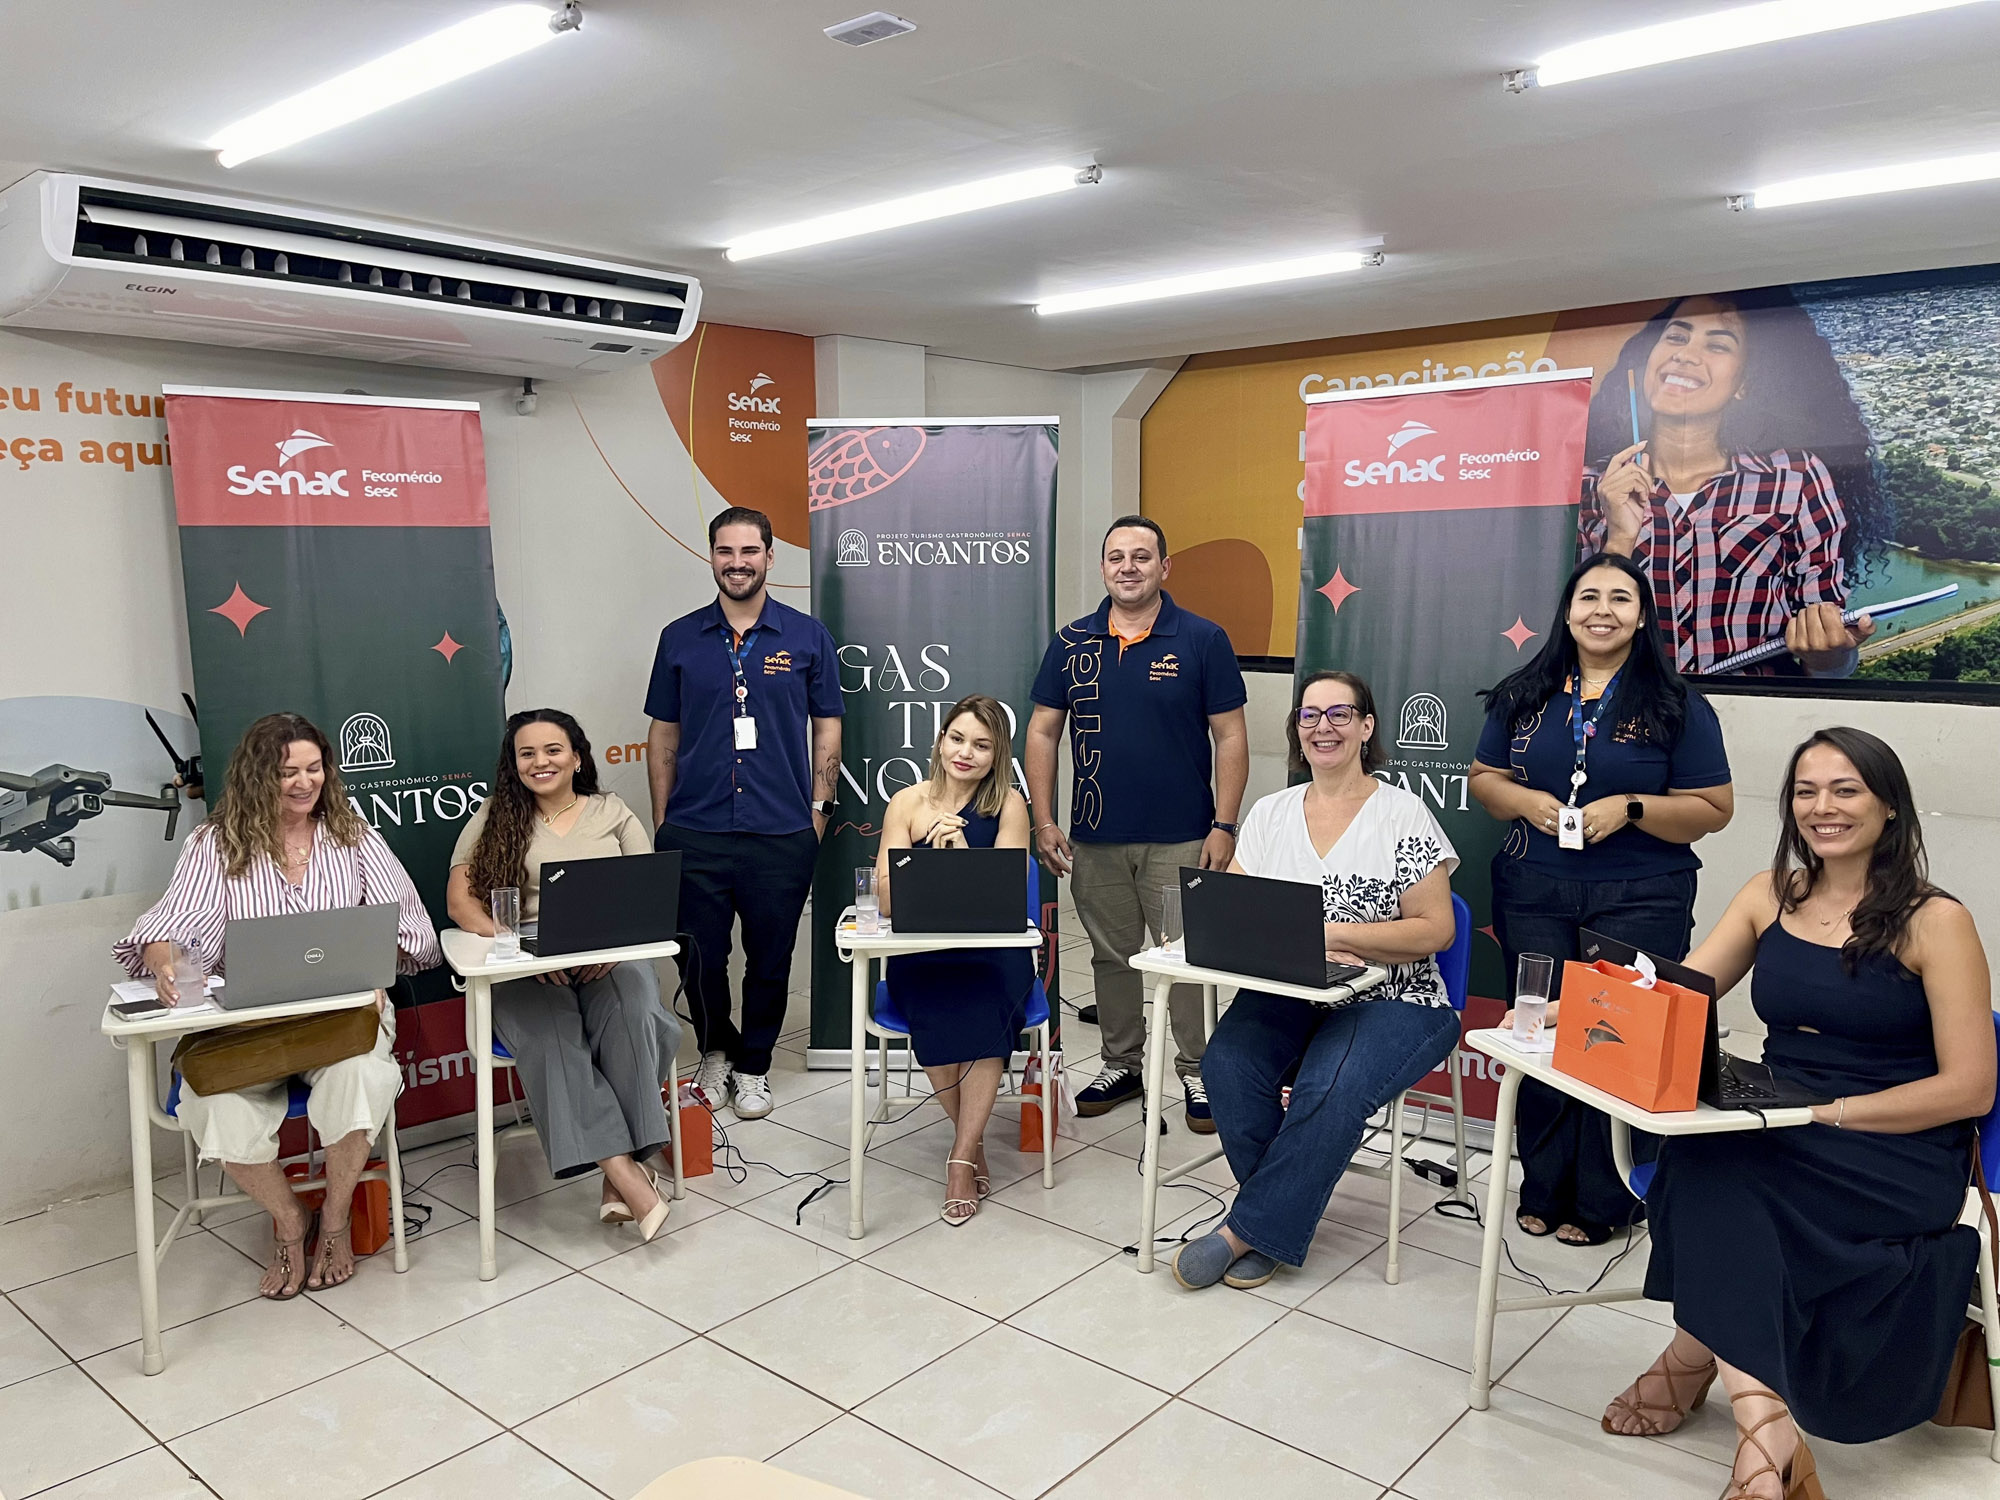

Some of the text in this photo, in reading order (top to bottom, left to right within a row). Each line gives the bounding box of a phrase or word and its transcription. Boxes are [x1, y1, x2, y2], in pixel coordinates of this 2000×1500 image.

[125, 283, 177, 295] ELGIN
[728, 417, 781, 431] Fecomércio
[730, 432, 752, 443] Sesc
[1458, 448, 1541, 466] Fecomércio
[361, 469, 443, 484] Fecomércio
[1458, 468, 1492, 480] Sesc
[364, 486, 399, 498] Sesc
[876, 540, 1031, 566] ENCANTOS
[836, 643, 951, 693] GAS
[360, 775, 439, 790] GASTRONÔMICO
[442, 771, 473, 781] SENAC
